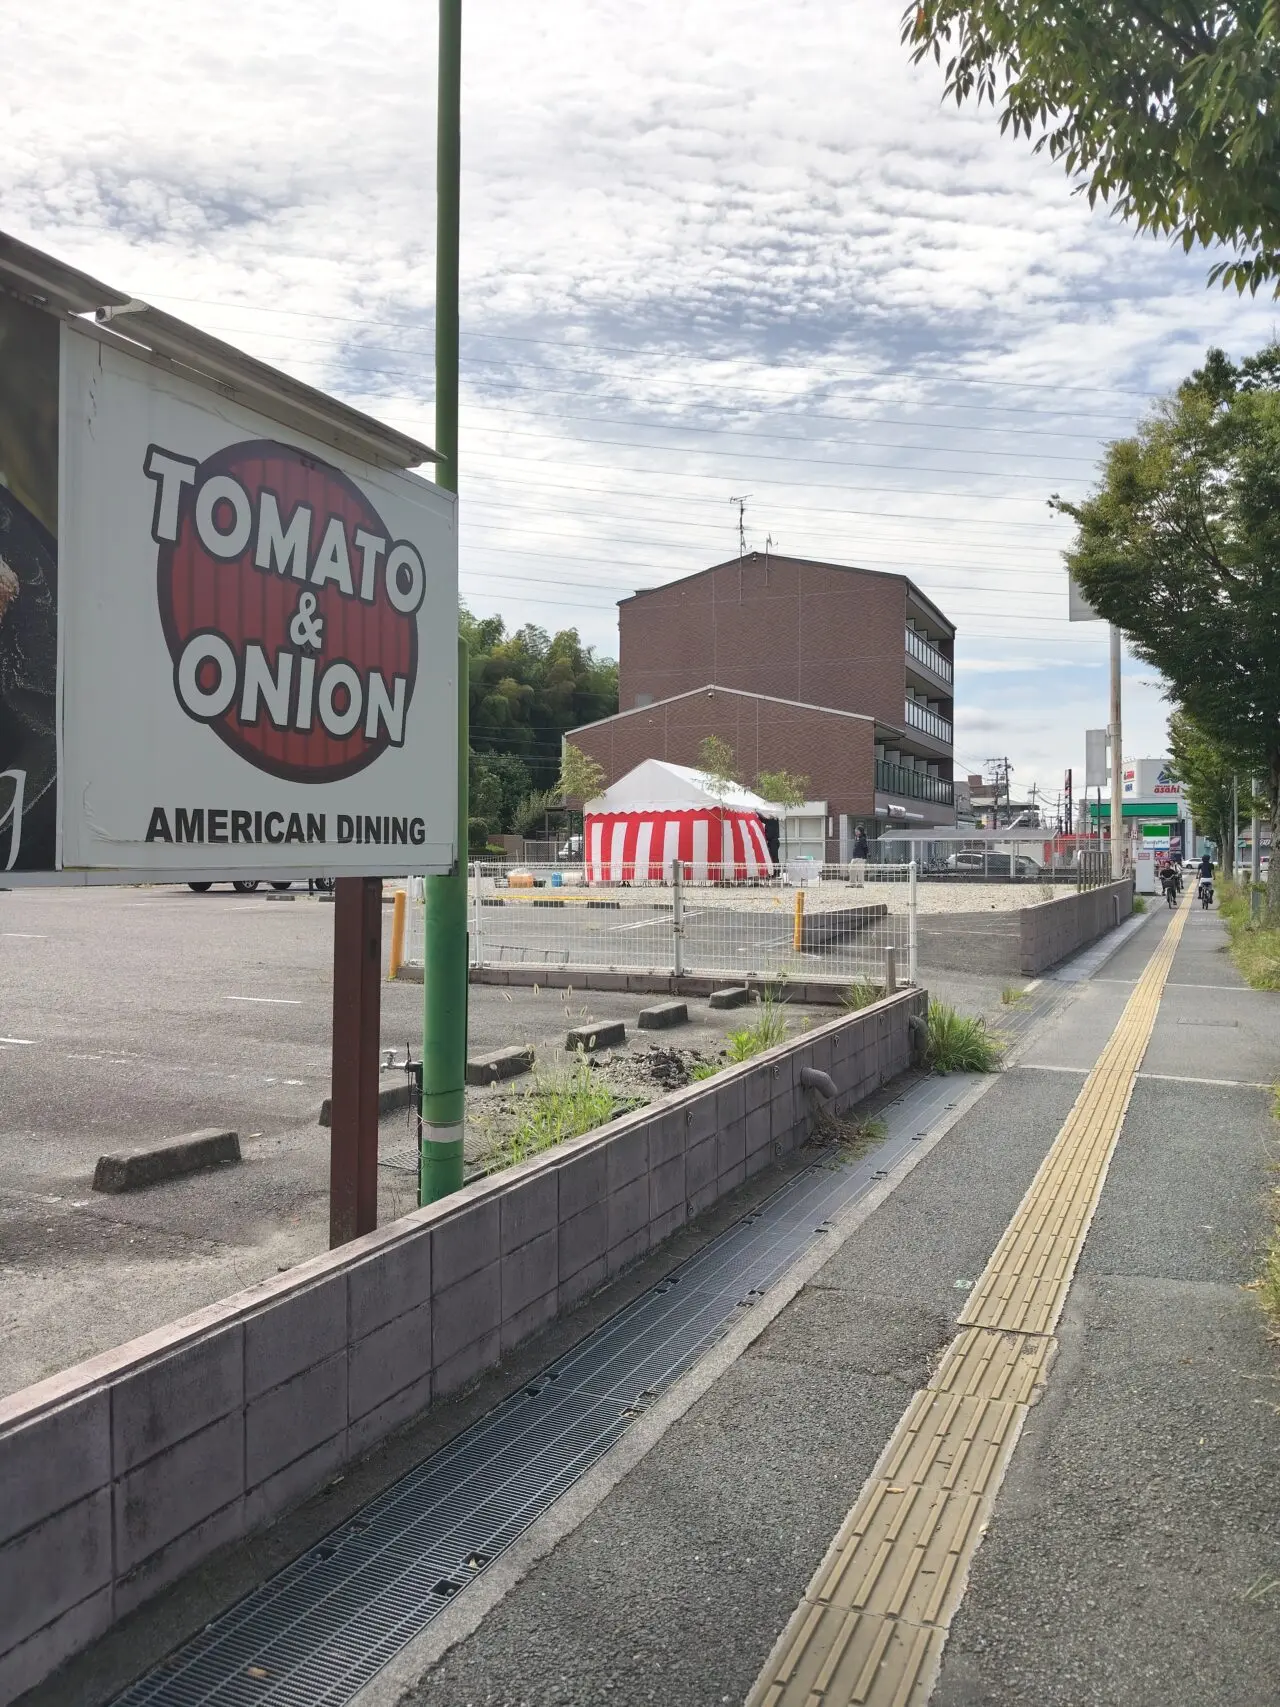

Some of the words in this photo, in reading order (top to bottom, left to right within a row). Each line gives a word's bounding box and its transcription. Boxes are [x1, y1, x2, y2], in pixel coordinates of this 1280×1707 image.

[146, 447, 425, 615] TOMATO
[289, 590, 323, 649] &
[177, 632, 408, 744] ONION
[1154, 785, 1180, 794] asahi
[145, 807, 327, 845] AMERICAN
[336, 813, 427, 846] DINING
